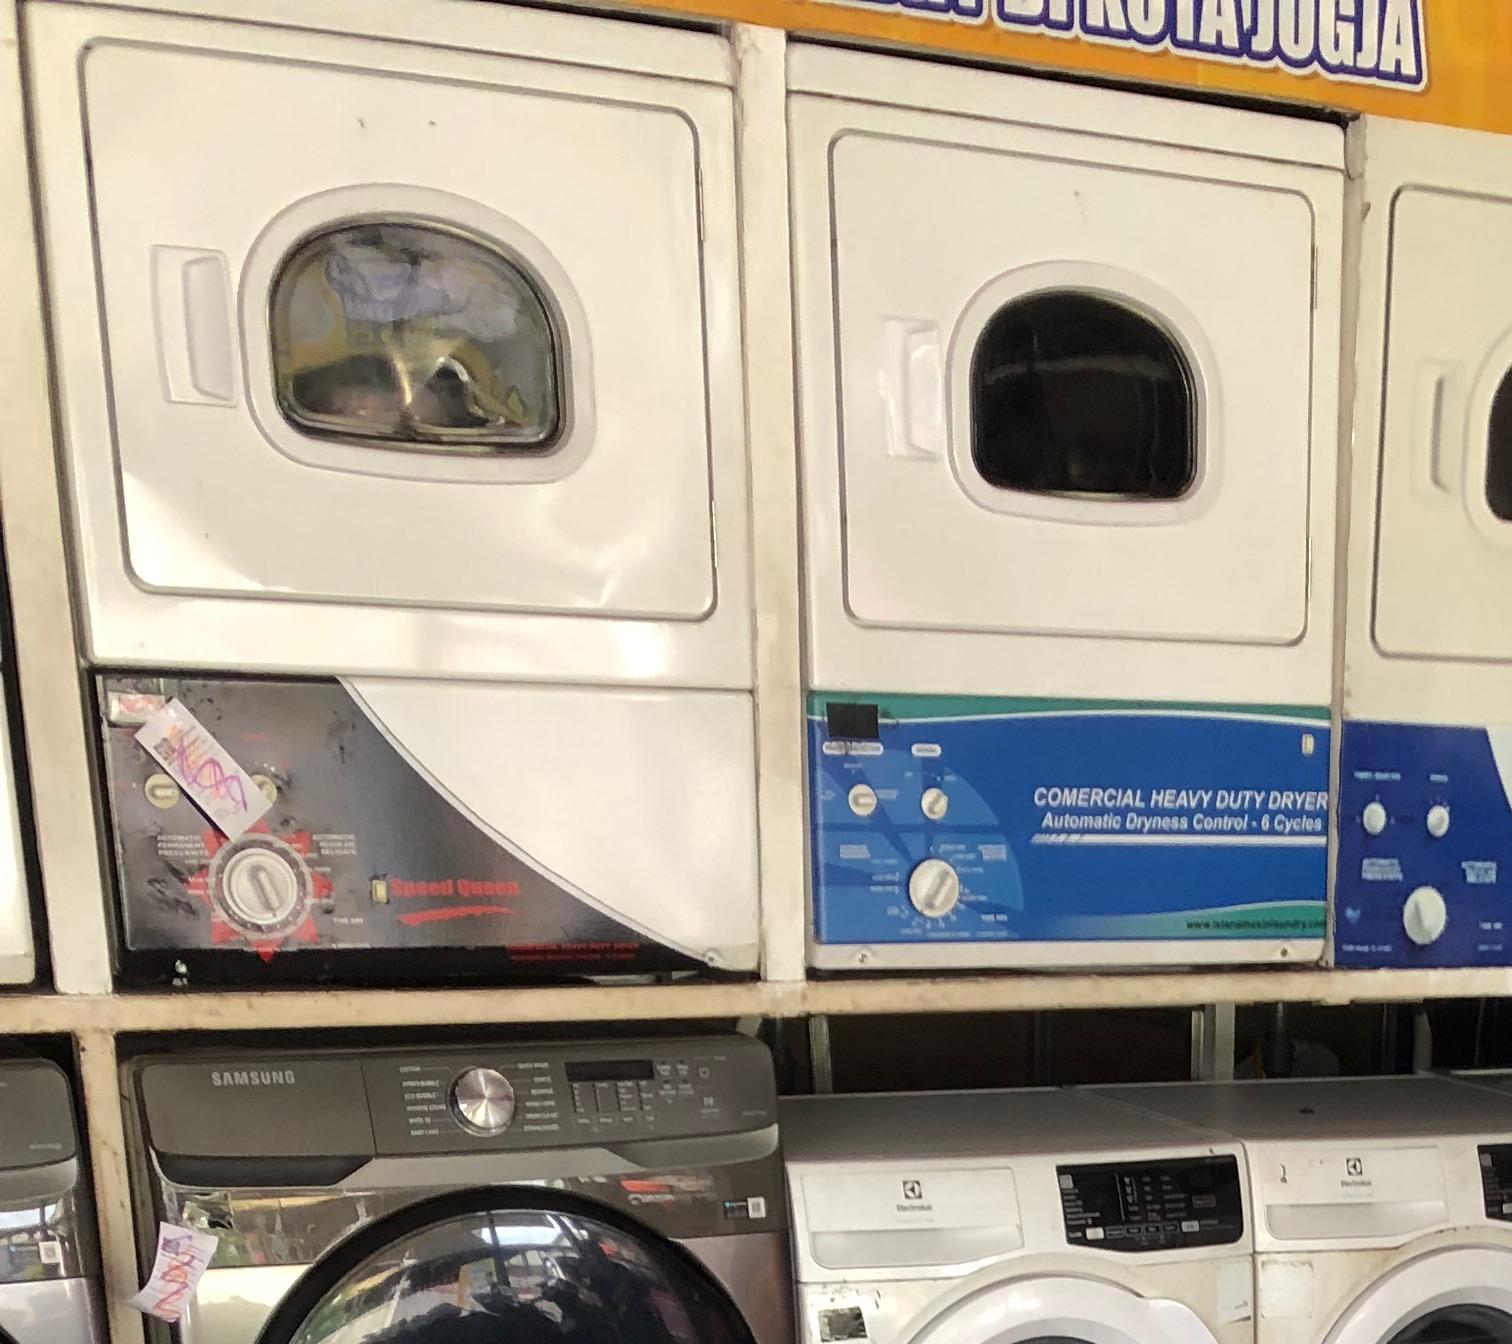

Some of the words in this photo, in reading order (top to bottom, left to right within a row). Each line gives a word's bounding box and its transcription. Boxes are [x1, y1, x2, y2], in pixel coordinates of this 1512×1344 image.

[1034, 787, 1146, 807] COMERCIAL
[1149, 789, 1214, 810] HEAVY
[1214, 790, 1265, 810] DUTY
[1267, 791, 1329, 811] DRYER
[1041, 811, 1122, 829] Automatic
[1125, 812, 1189, 834] Dryness
[1192, 812, 1249, 832] Control
[1260, 813, 1270, 831] 6
[1273, 814, 1322, 834] Cycles
[211, 1070, 295, 1087] SAMSUNG
